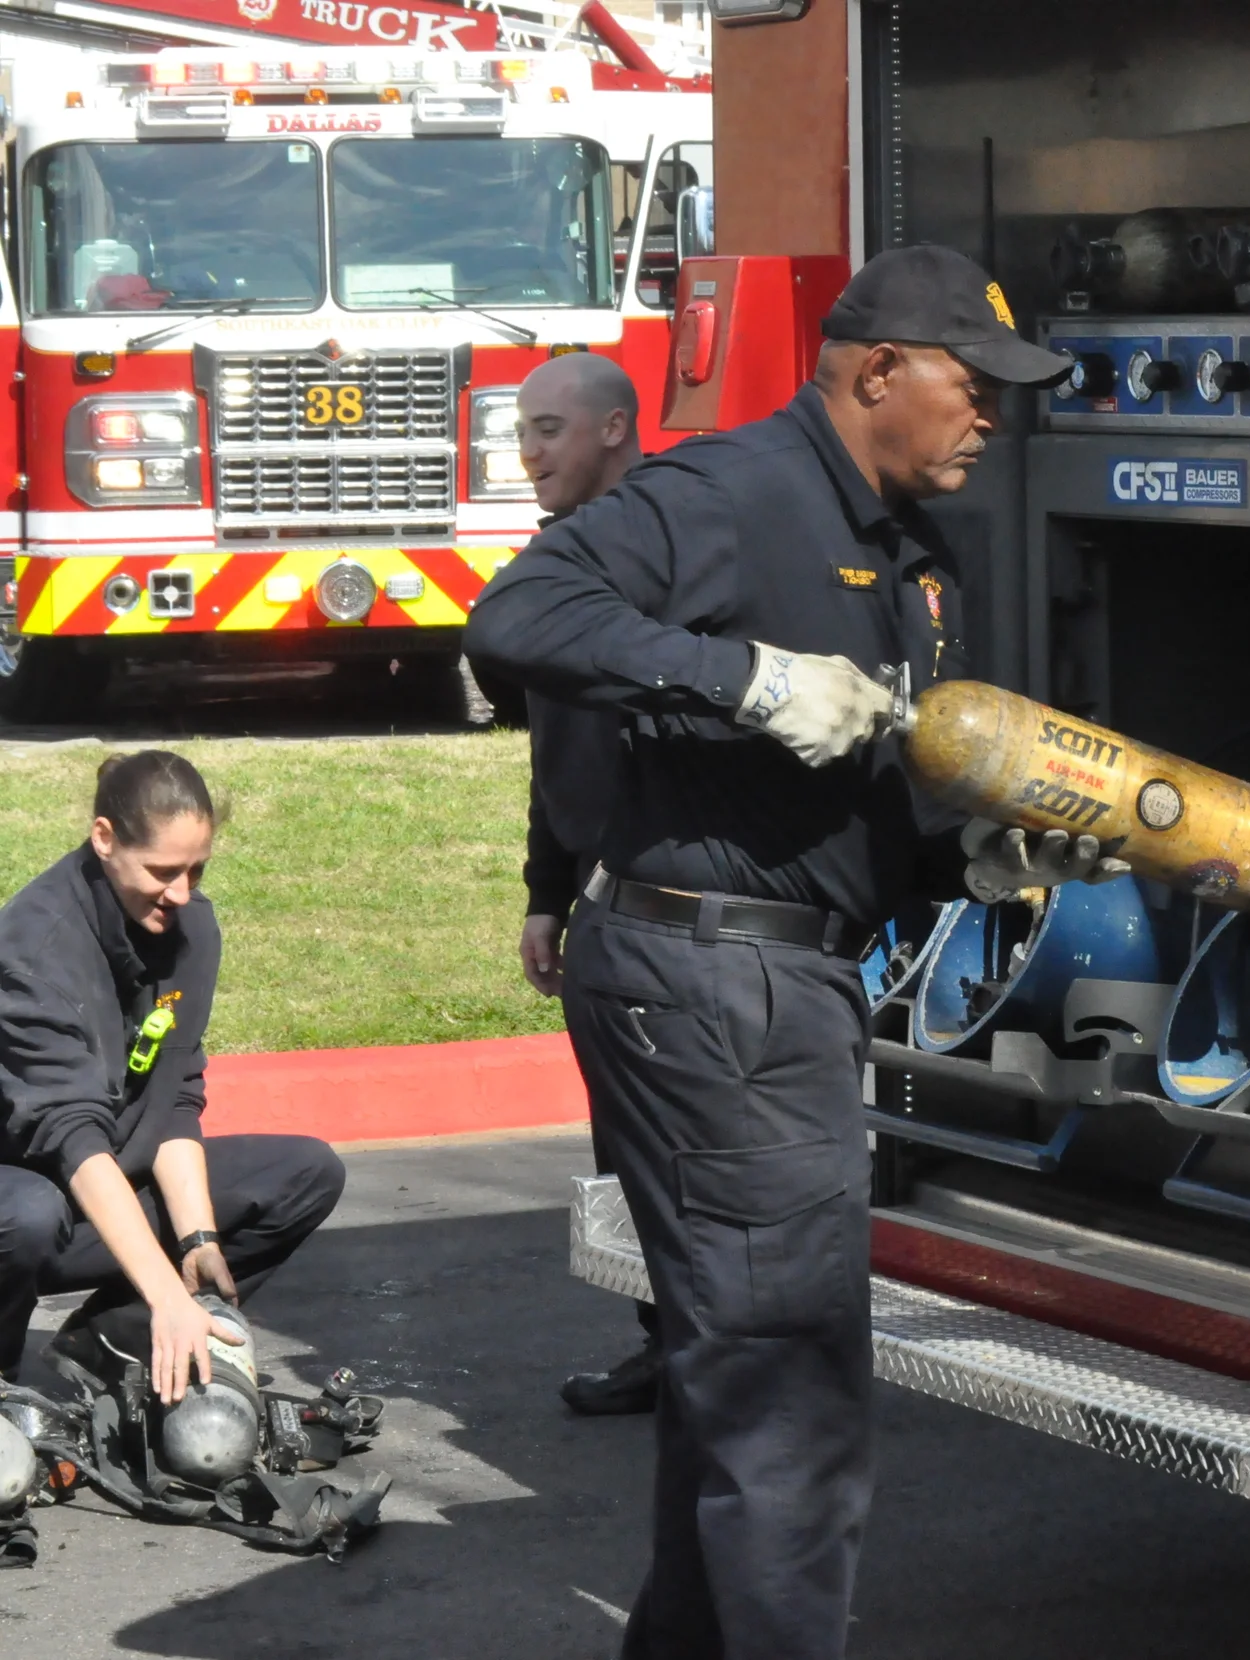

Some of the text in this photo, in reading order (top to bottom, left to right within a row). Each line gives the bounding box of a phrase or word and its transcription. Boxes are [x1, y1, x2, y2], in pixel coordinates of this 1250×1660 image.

[302, 0, 477, 51] TRUCK
[266, 113, 382, 133] DALLAS
[306, 386, 364, 424] 38
[1185, 468, 1238, 485] BAUER
[1186, 488, 1239, 501] COMPRESSORS
[1038, 720, 1123, 769] SCOTT
[1045, 759, 1106, 791] AIR-PAK
[1024, 778, 1113, 828] SCOTT
